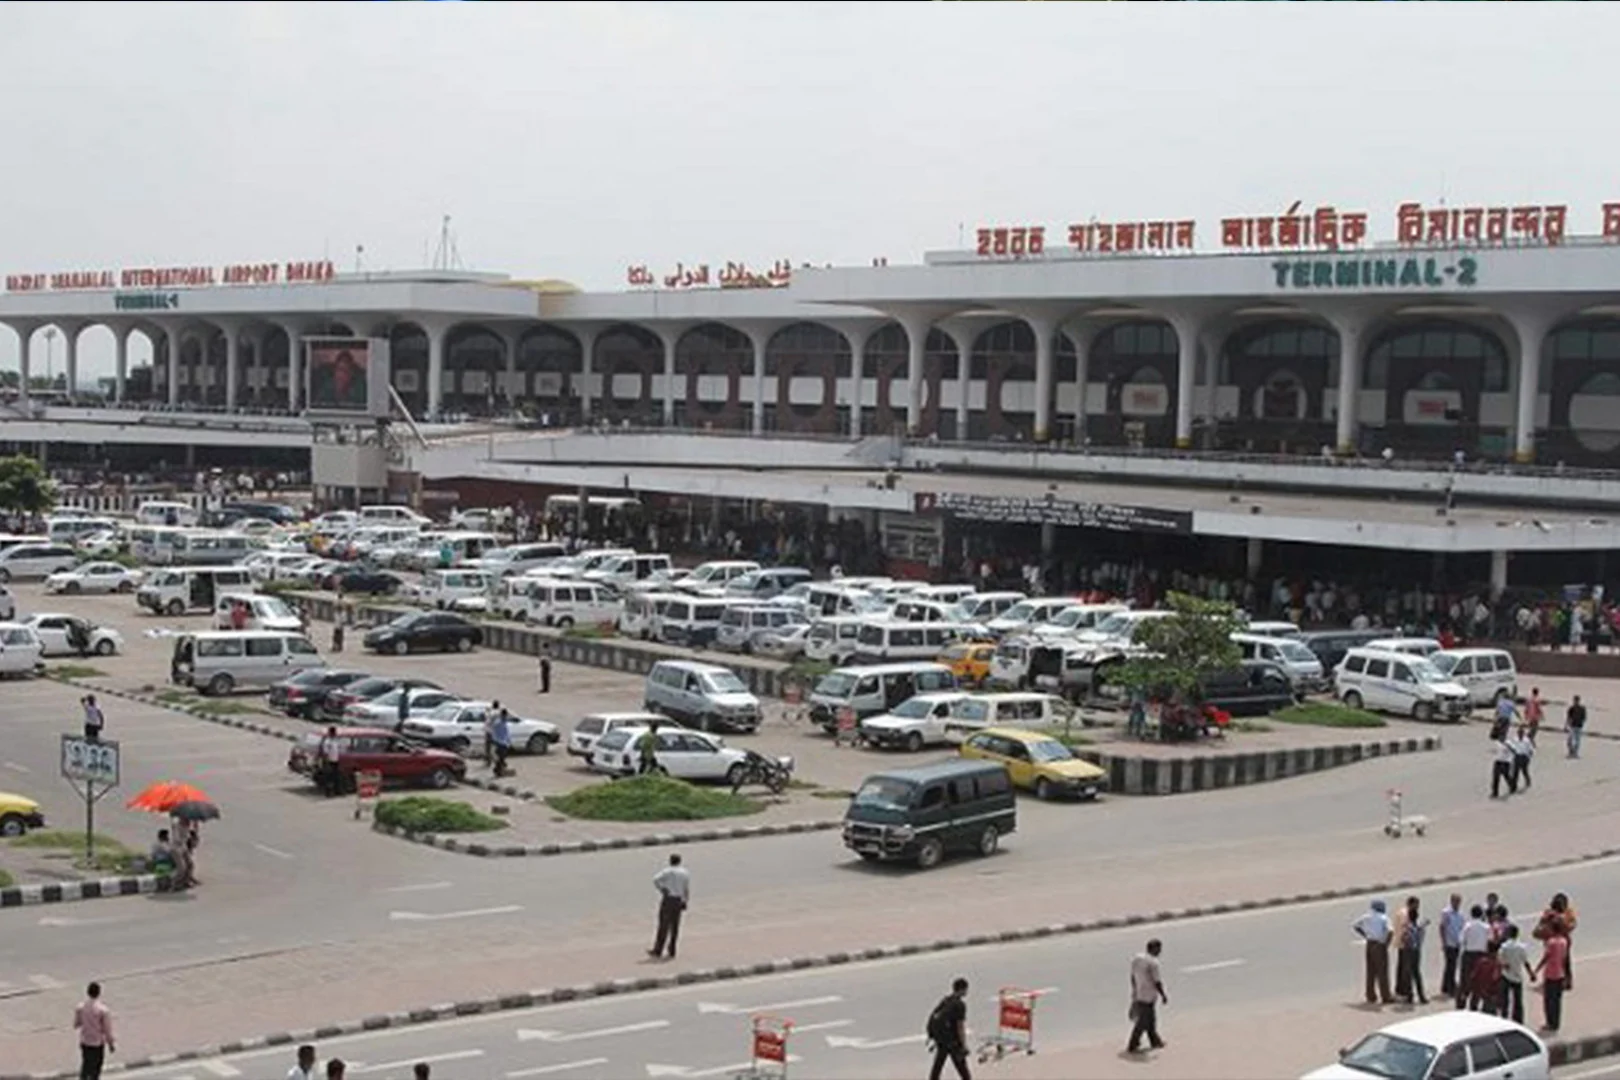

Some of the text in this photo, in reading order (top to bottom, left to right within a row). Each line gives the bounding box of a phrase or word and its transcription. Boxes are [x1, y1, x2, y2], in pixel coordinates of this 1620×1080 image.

[977, 226, 1045, 256] হযরত
[1068, 221, 1195, 251] শাহজালাল
[1397, 203, 1567, 246] বিমানবন্দর
[223, 263, 279, 282] AIRPORT
[1272, 257, 1479, 288] TERMINAL-2
